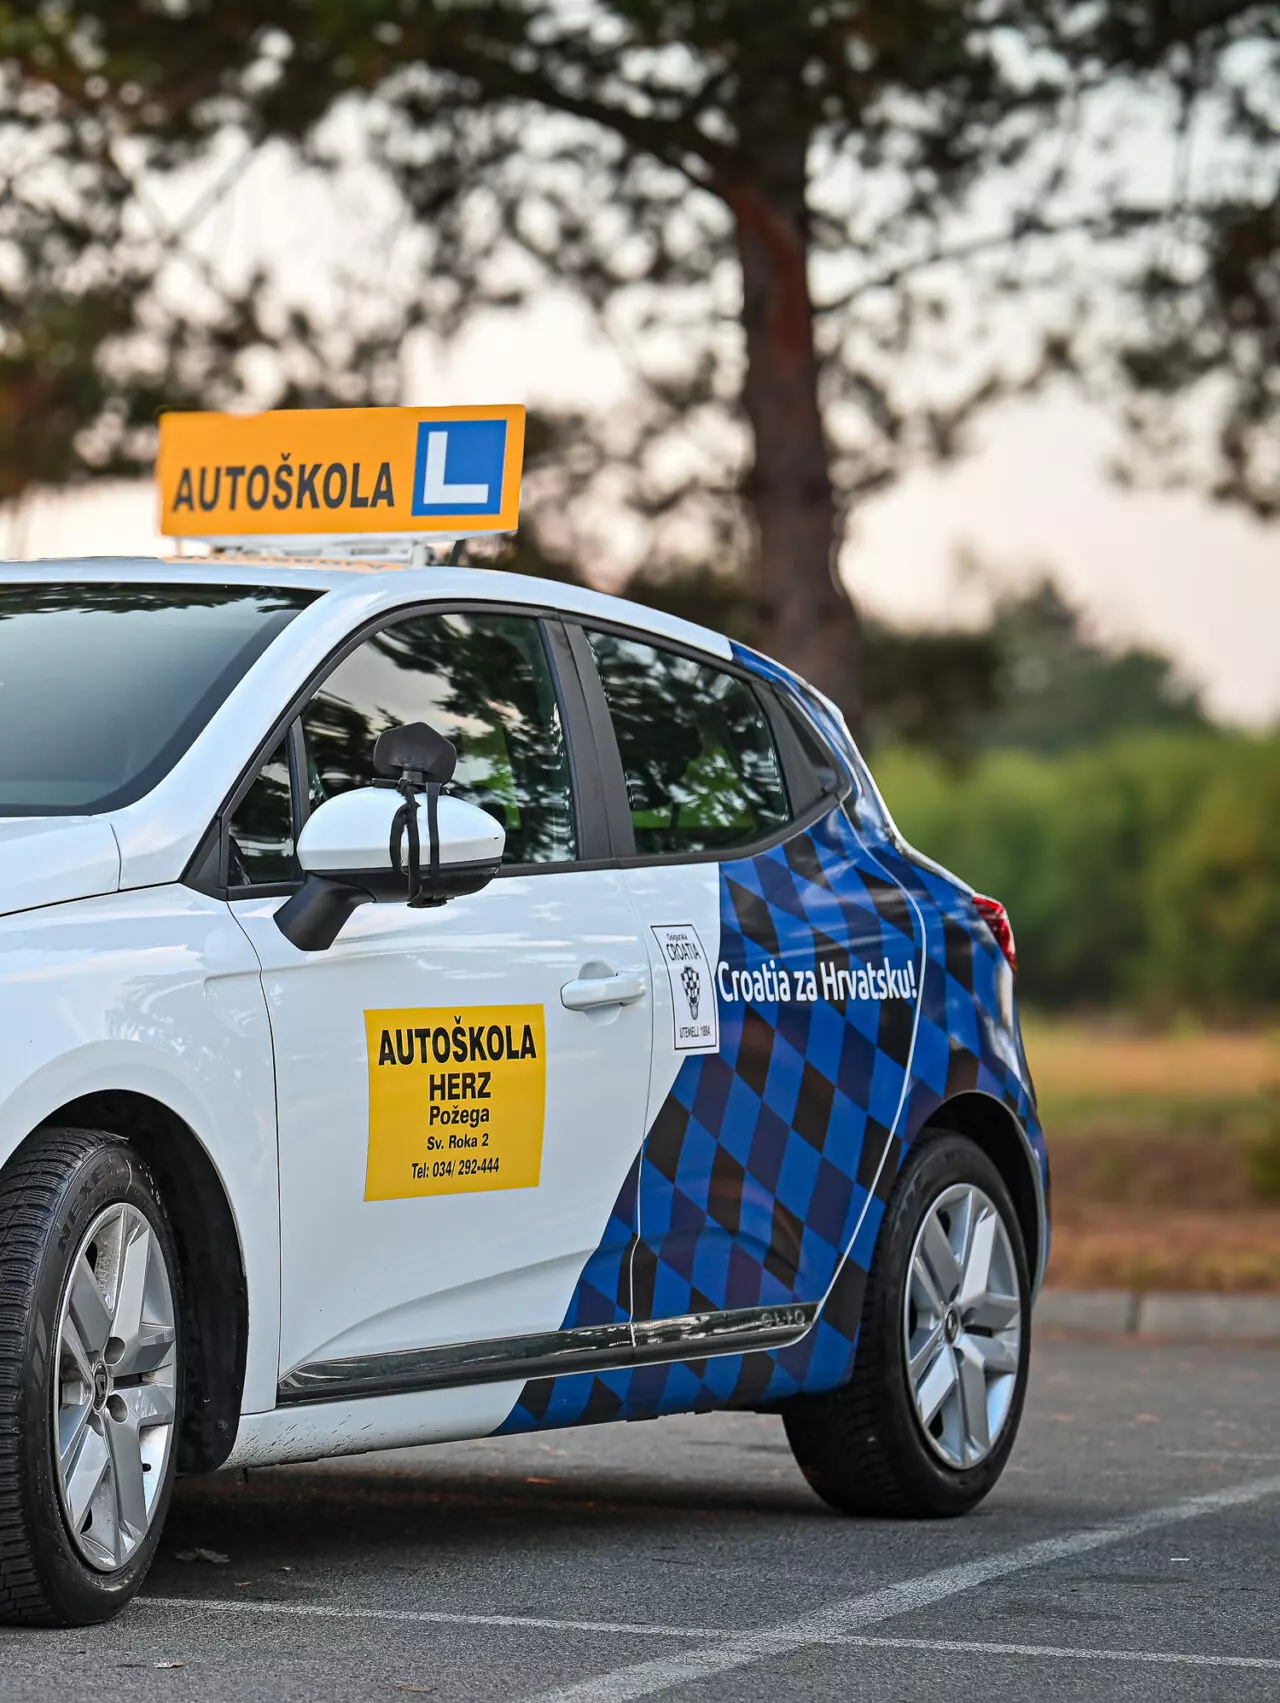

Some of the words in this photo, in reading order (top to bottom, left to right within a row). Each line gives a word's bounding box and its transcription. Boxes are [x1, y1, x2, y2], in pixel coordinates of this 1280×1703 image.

[173, 452, 396, 512] AUTOŠKOLA
[422, 431, 489, 504] L
[666, 943, 702, 961] CROATIA
[717, 959, 791, 1003] Croatia
[794, 970, 818, 1003] za
[820, 957, 919, 1001] Hrvatsku!
[378, 1016, 537, 1066] AUTOŠKOLA
[429, 1072, 492, 1101] HERZ
[429, 1104, 490, 1128] Požega
[427, 1136, 445, 1151] Sv.
[448, 1134, 478, 1149] Roka
[482, 1133, 489, 1147] 2
[412, 1163, 429, 1179] Tel:
[432, 1160, 456, 1178] 034/
[458, 1157, 500, 1176] 292-444
